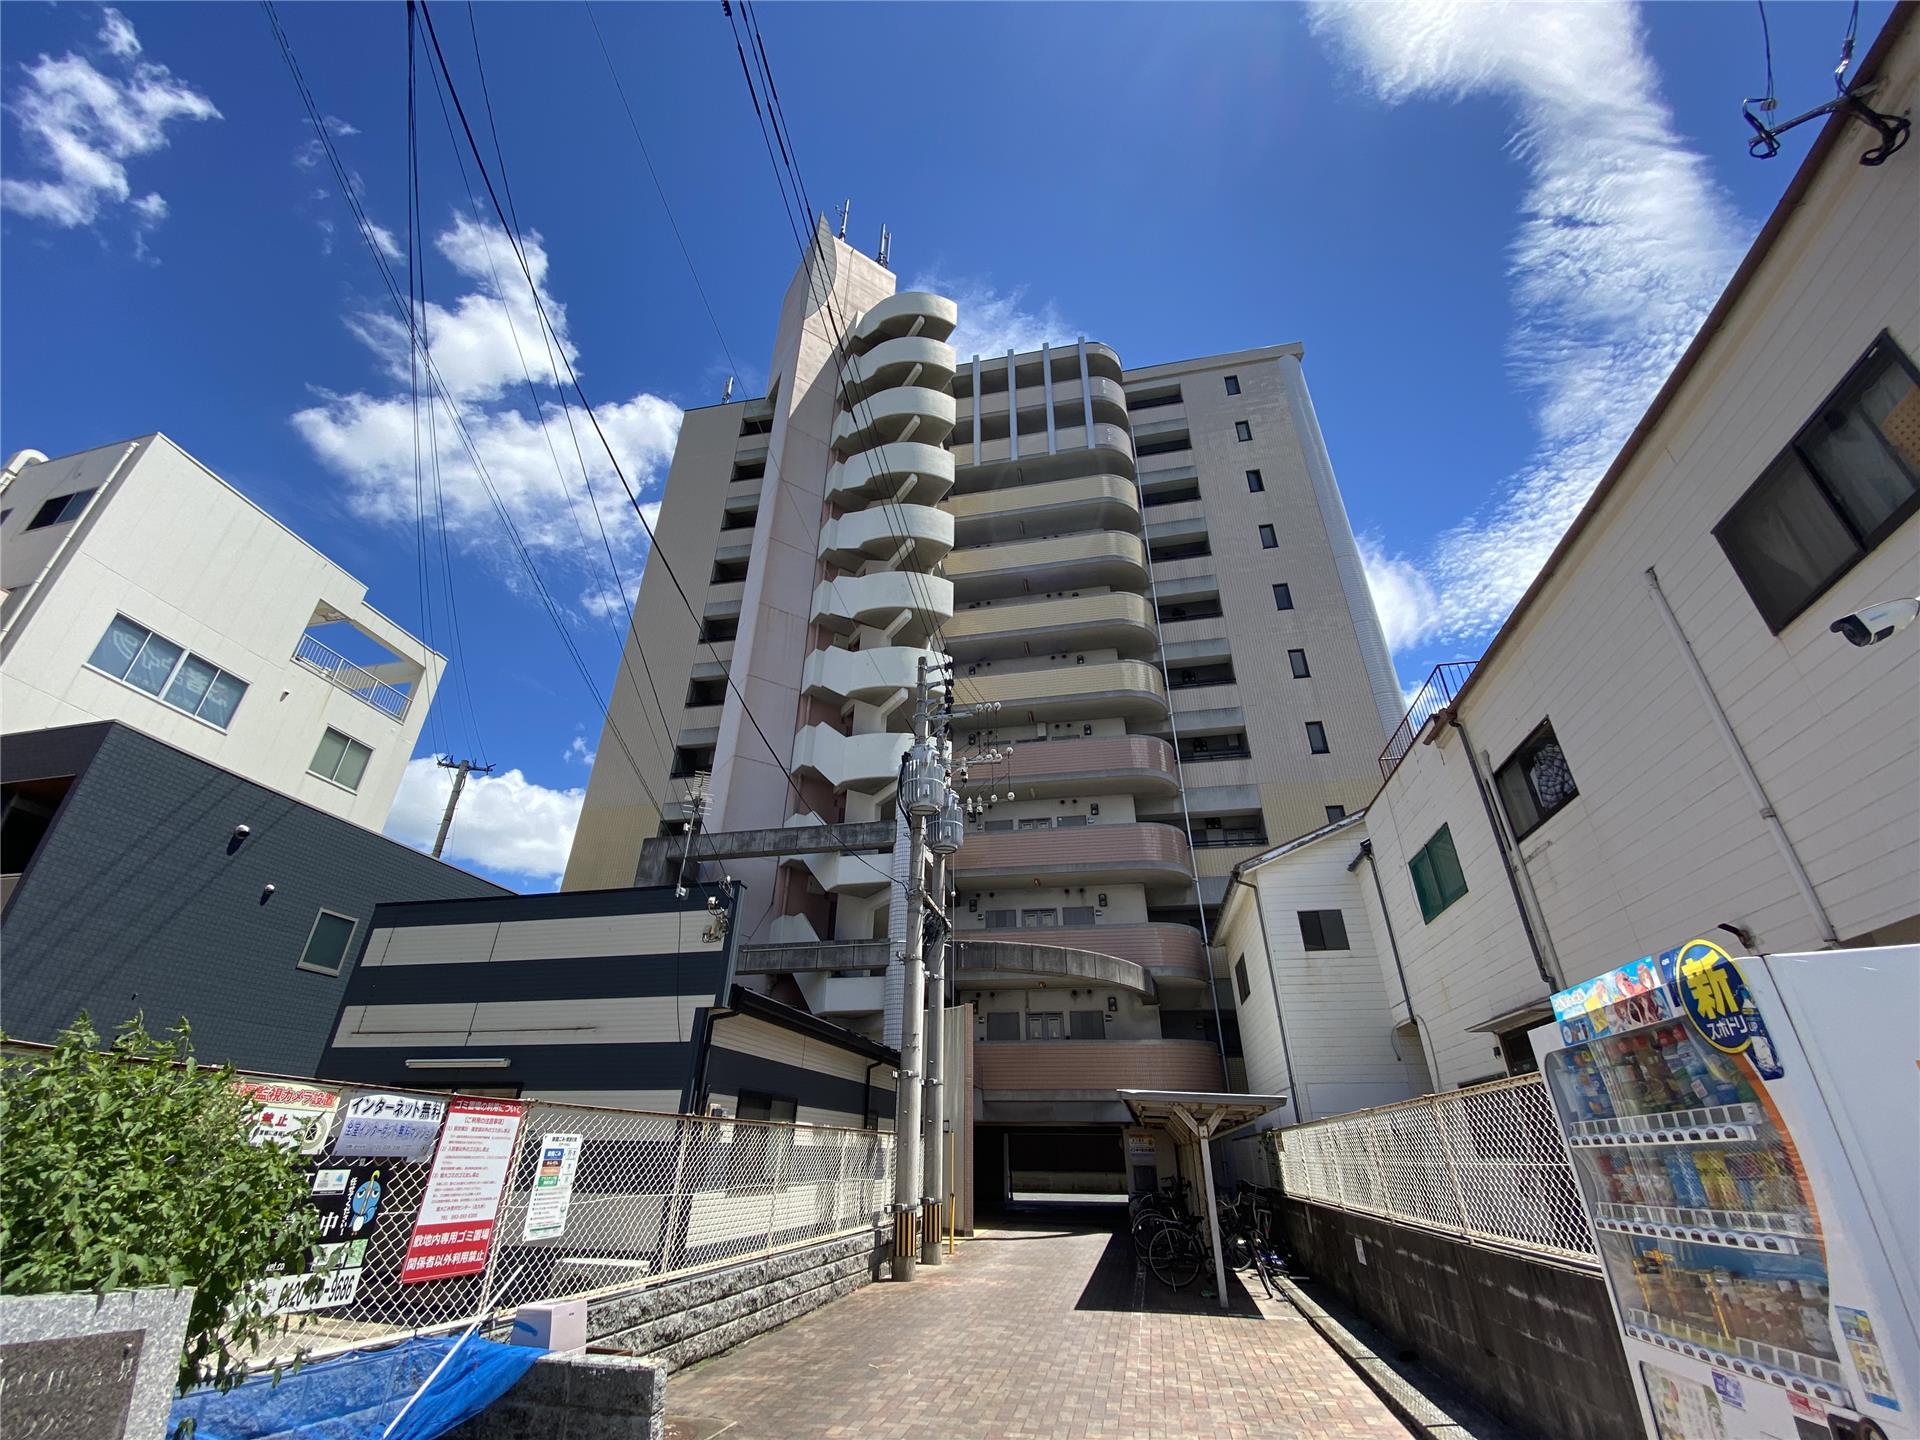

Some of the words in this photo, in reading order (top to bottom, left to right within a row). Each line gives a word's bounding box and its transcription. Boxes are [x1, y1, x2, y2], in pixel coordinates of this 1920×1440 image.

[1681, 949, 1739, 1019] 新
[352, 1097, 441, 1120] インターネット無料
[412, 1228, 491, 1249] 敷地内専用ゴミ置場
[406, 1249, 485, 1272] 関係者以外利用禁止
